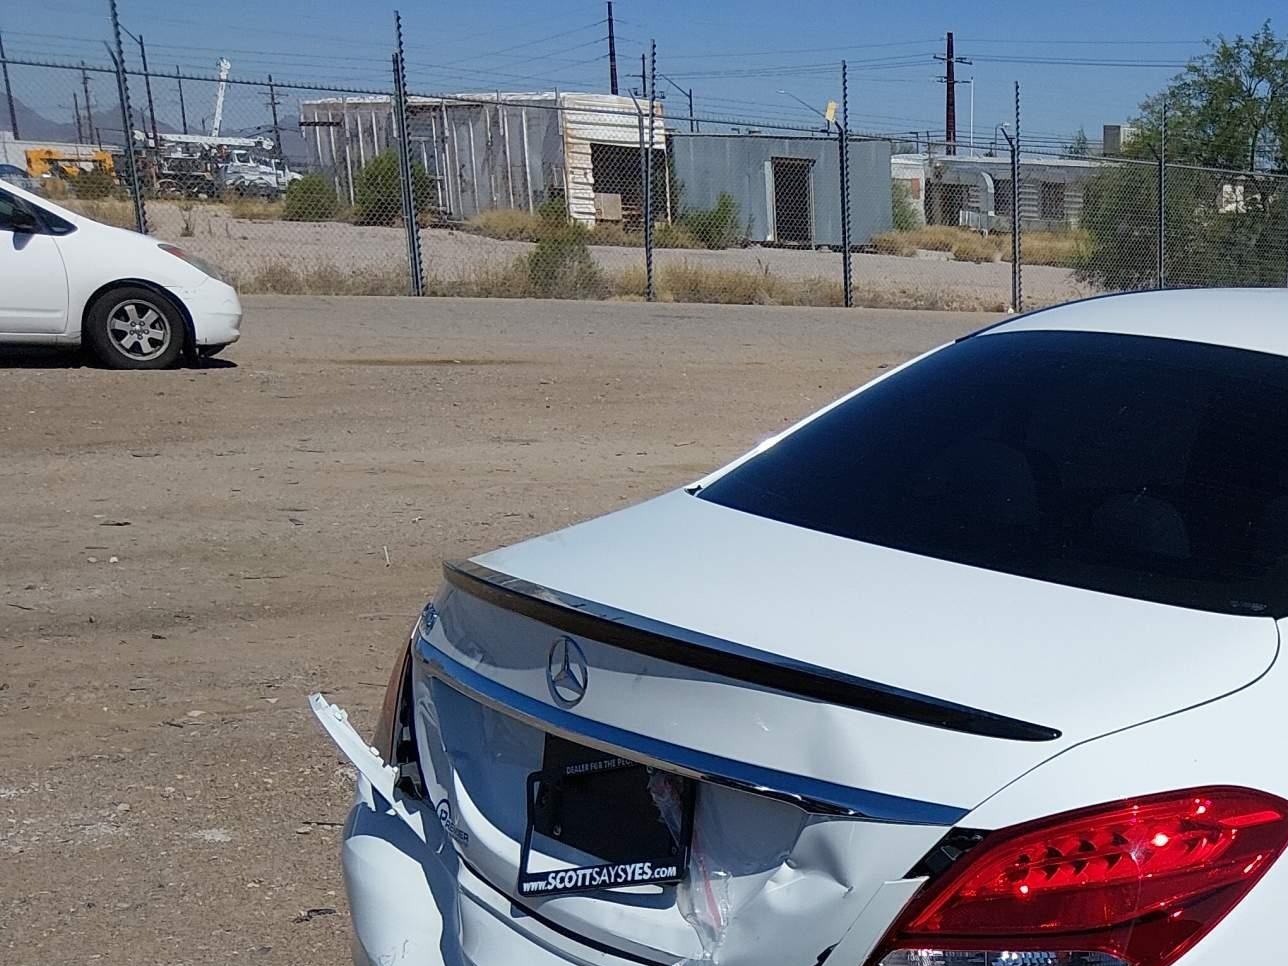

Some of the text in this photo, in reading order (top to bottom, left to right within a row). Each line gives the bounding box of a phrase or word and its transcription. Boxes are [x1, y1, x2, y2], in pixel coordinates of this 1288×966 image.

[566, 762, 589, 775] DEALER
[590, 761, 603, 770] FOR
[604, 758, 616, 769] THE
